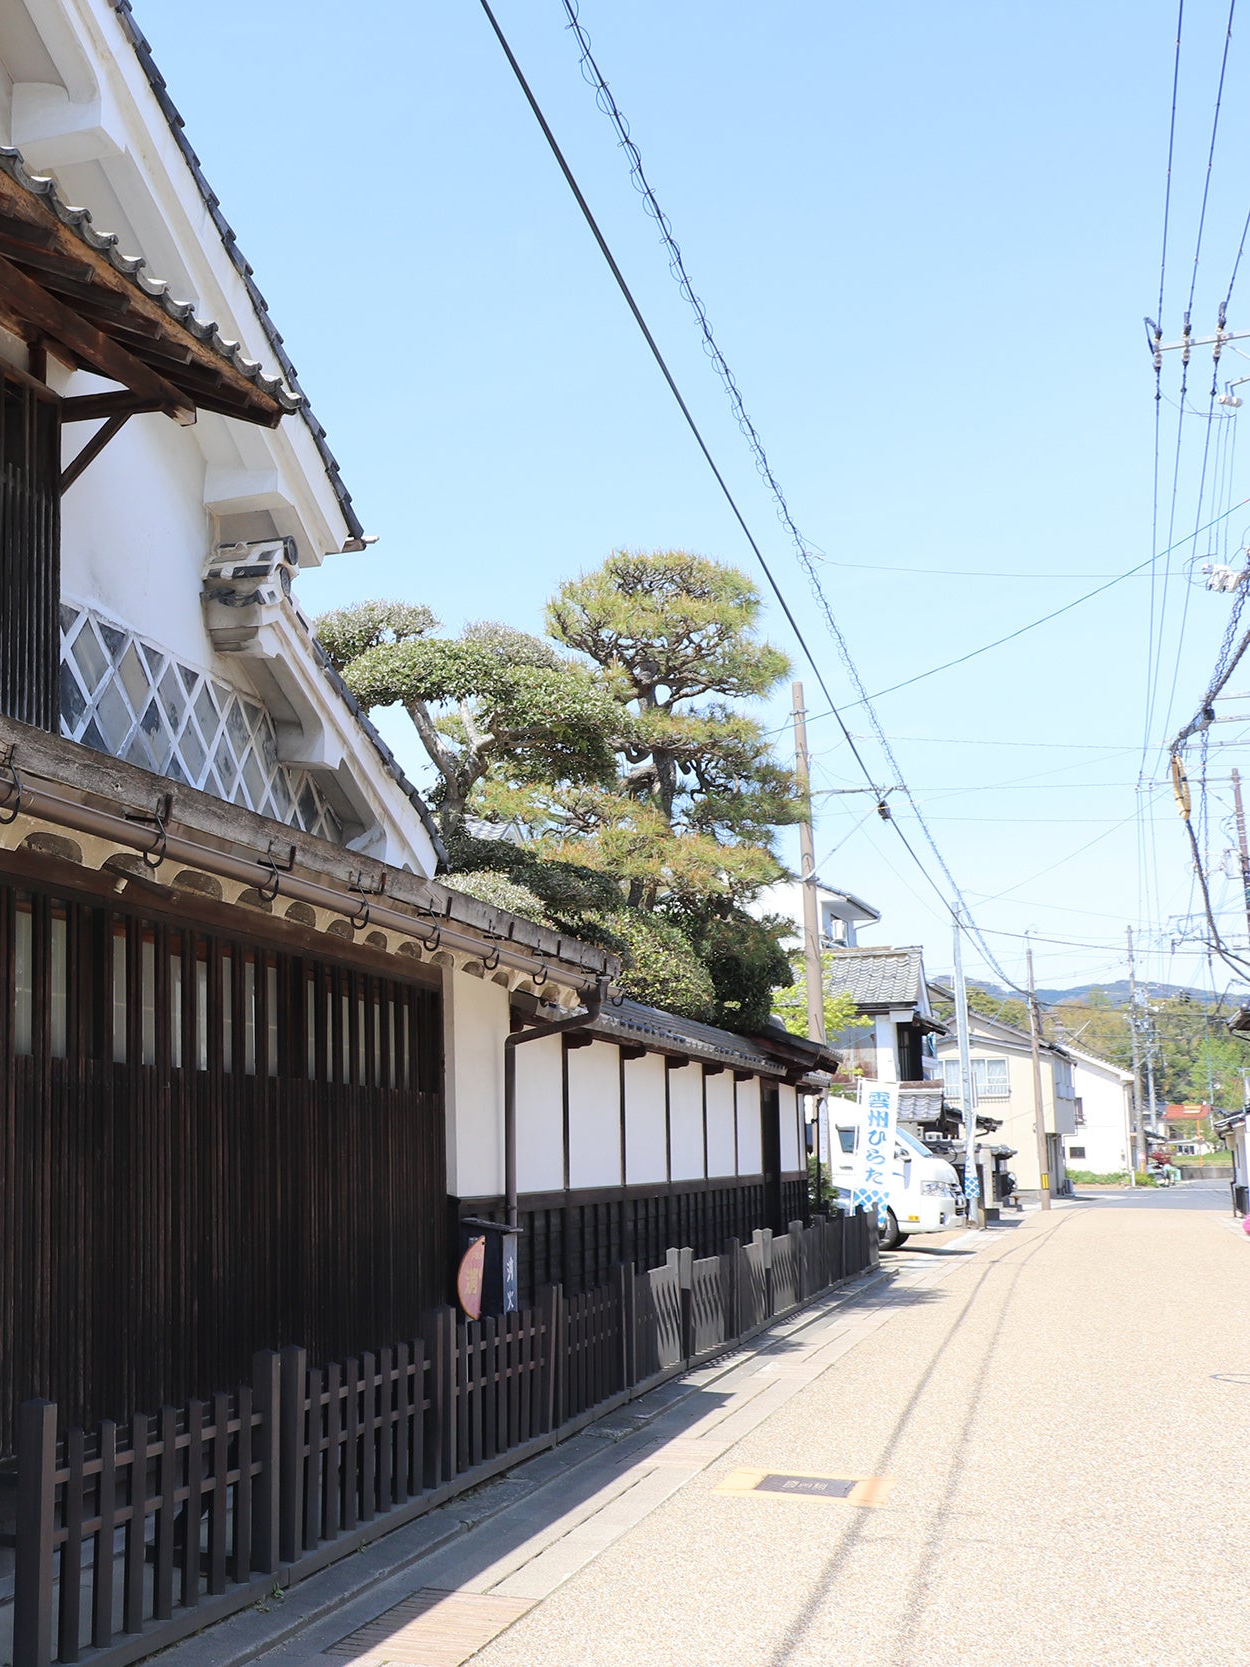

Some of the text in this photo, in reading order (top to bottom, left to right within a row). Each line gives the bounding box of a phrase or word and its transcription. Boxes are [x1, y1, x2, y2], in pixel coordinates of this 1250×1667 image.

[865, 1091, 890, 1185] 雲州ひらた
